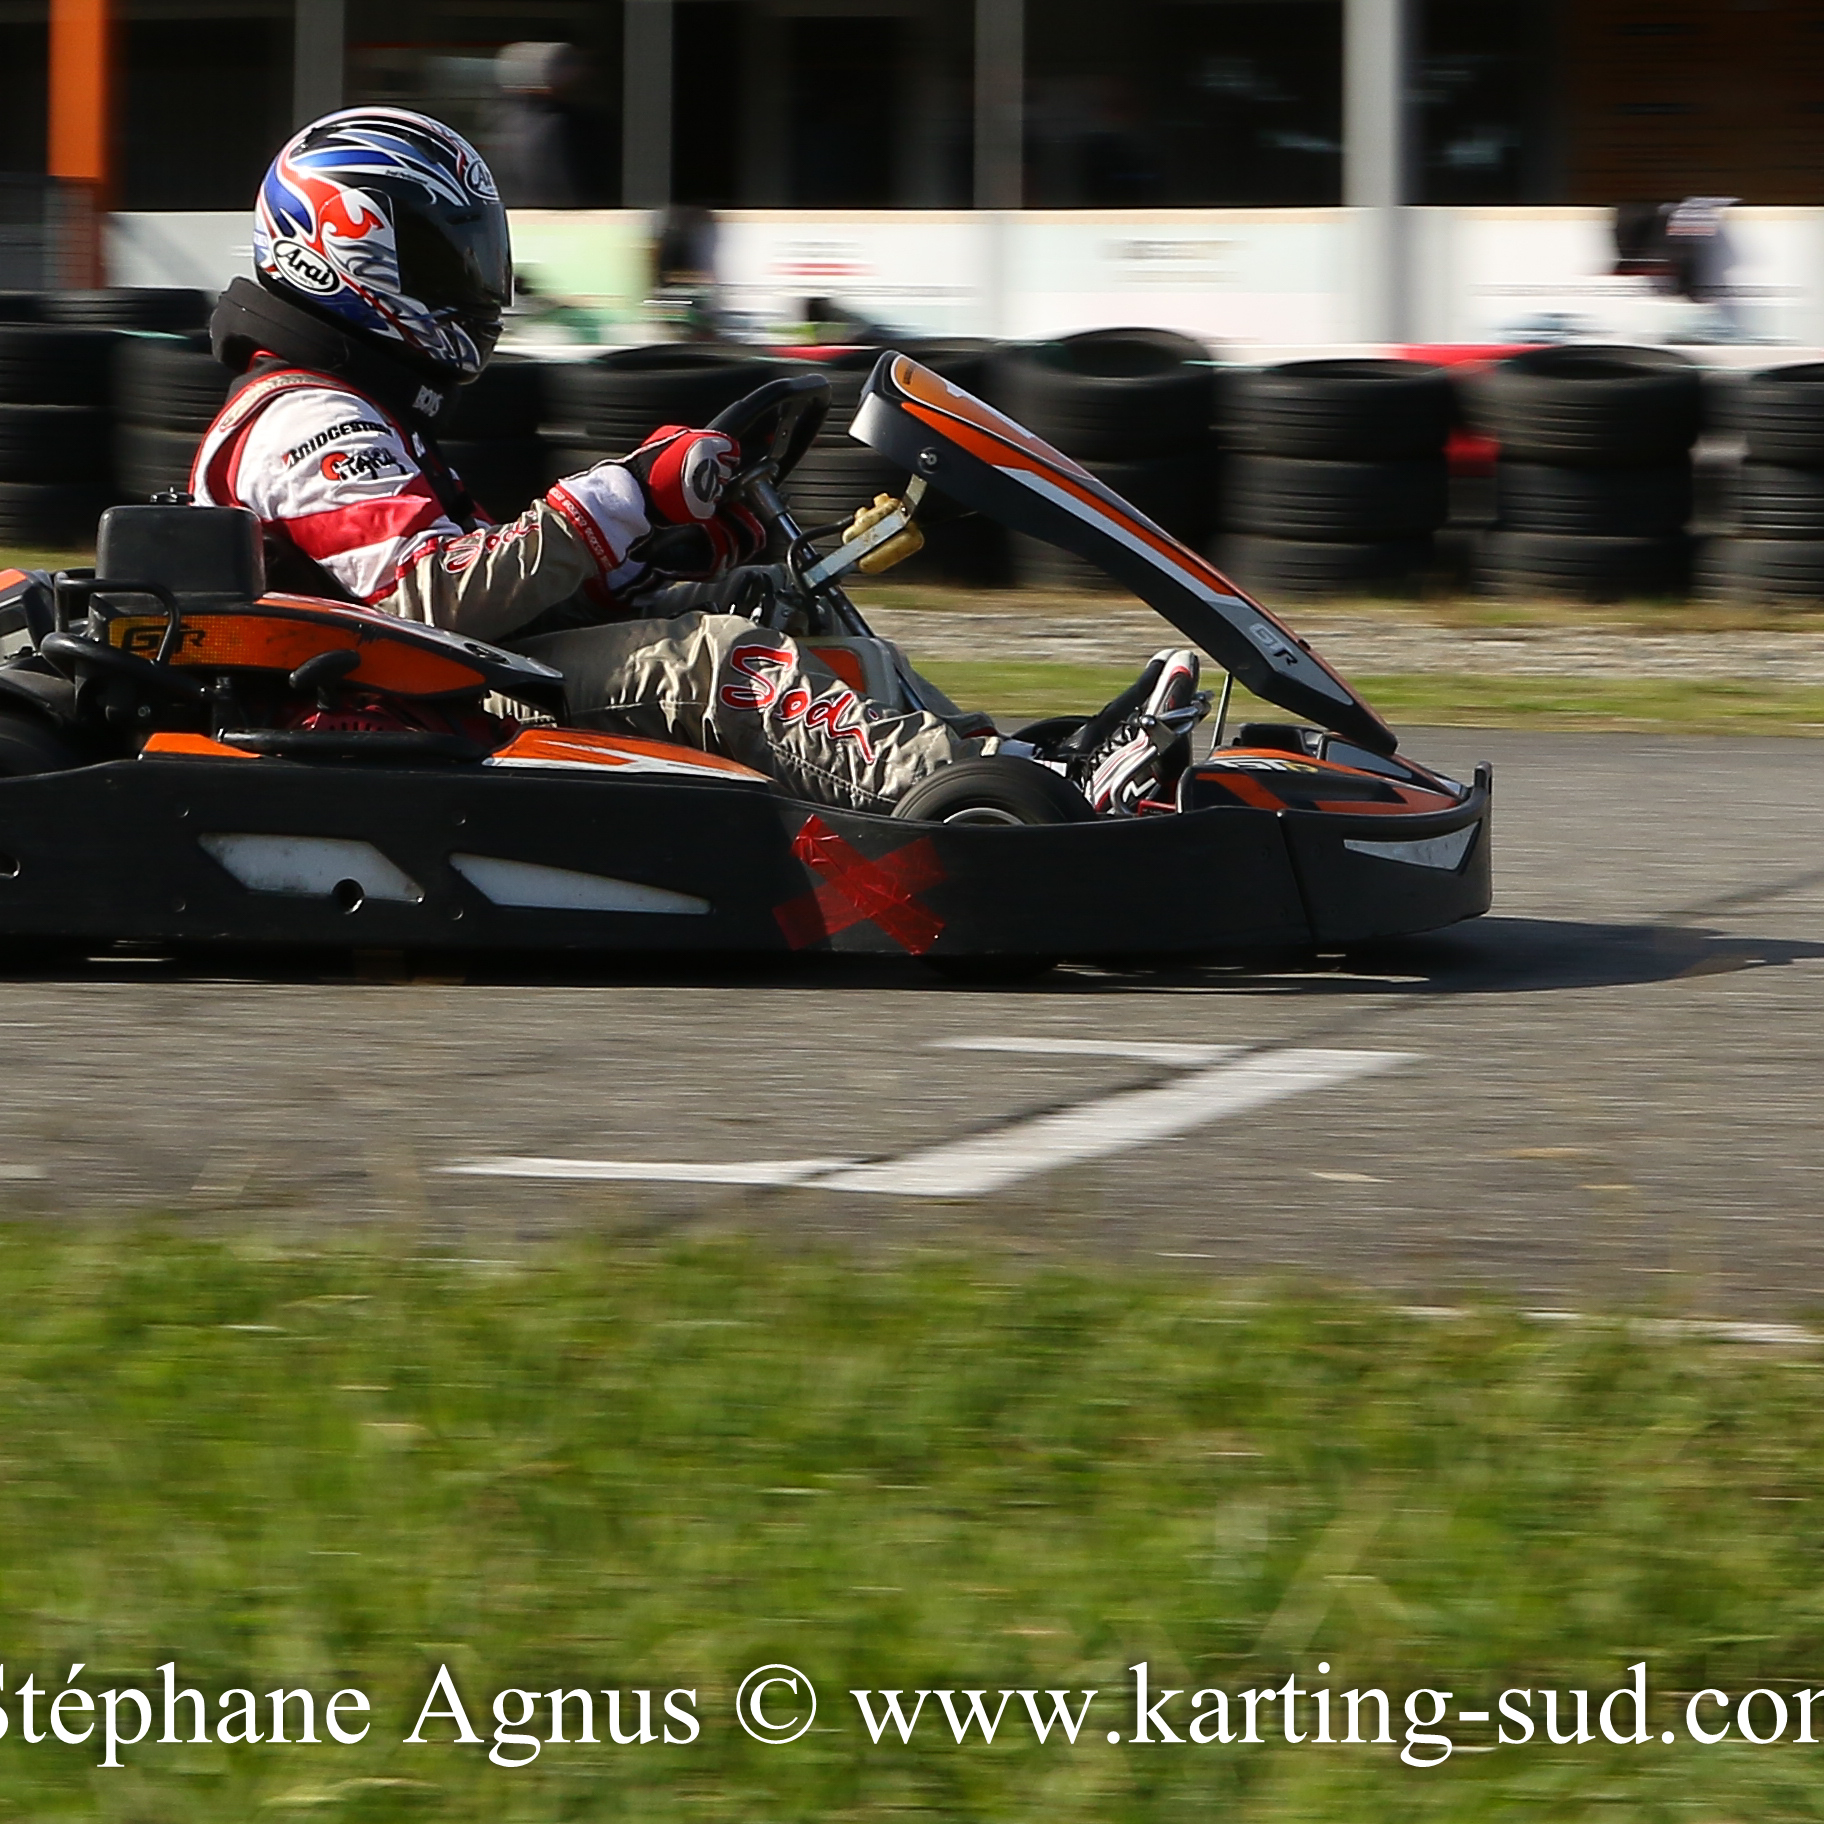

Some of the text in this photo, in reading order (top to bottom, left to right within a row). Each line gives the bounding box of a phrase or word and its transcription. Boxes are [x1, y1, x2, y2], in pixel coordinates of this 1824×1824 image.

[275, 247, 334, 286] Arai
[1248, 623, 1299, 668] GTR
[720, 644, 880, 765] Sodi
